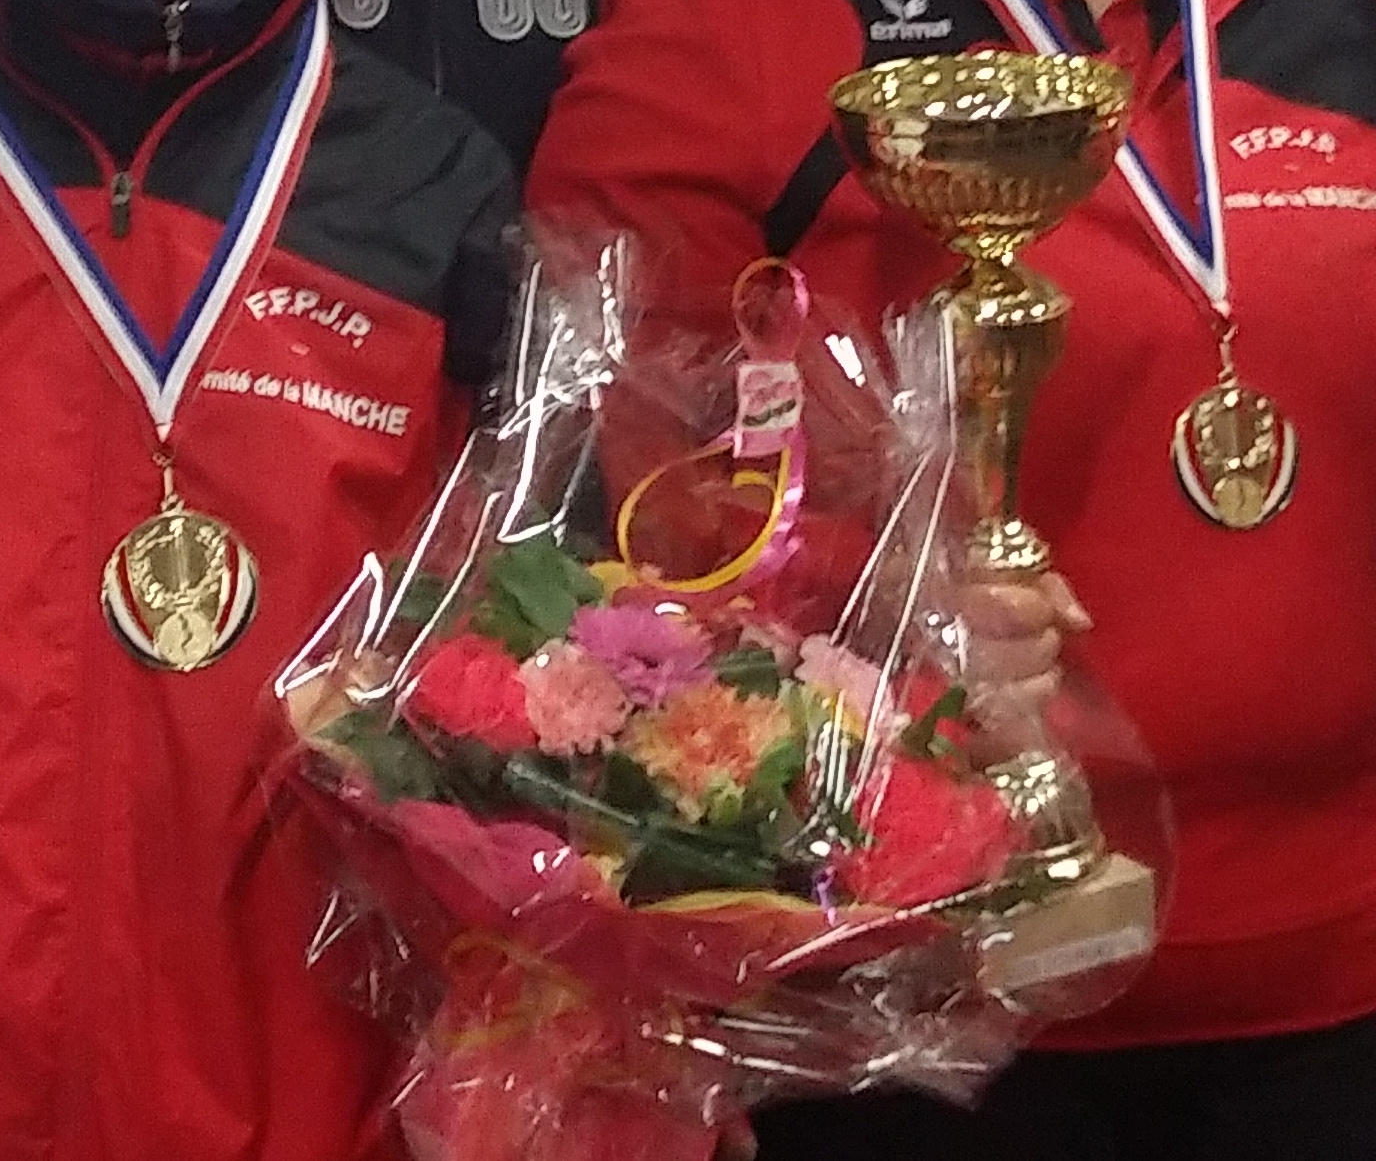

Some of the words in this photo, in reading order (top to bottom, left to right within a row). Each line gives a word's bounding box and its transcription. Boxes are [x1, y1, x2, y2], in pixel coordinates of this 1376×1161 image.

[201, 367, 252, 395] mité
[253, 372, 283, 398] de
[302, 379, 413, 437] MANCHE
